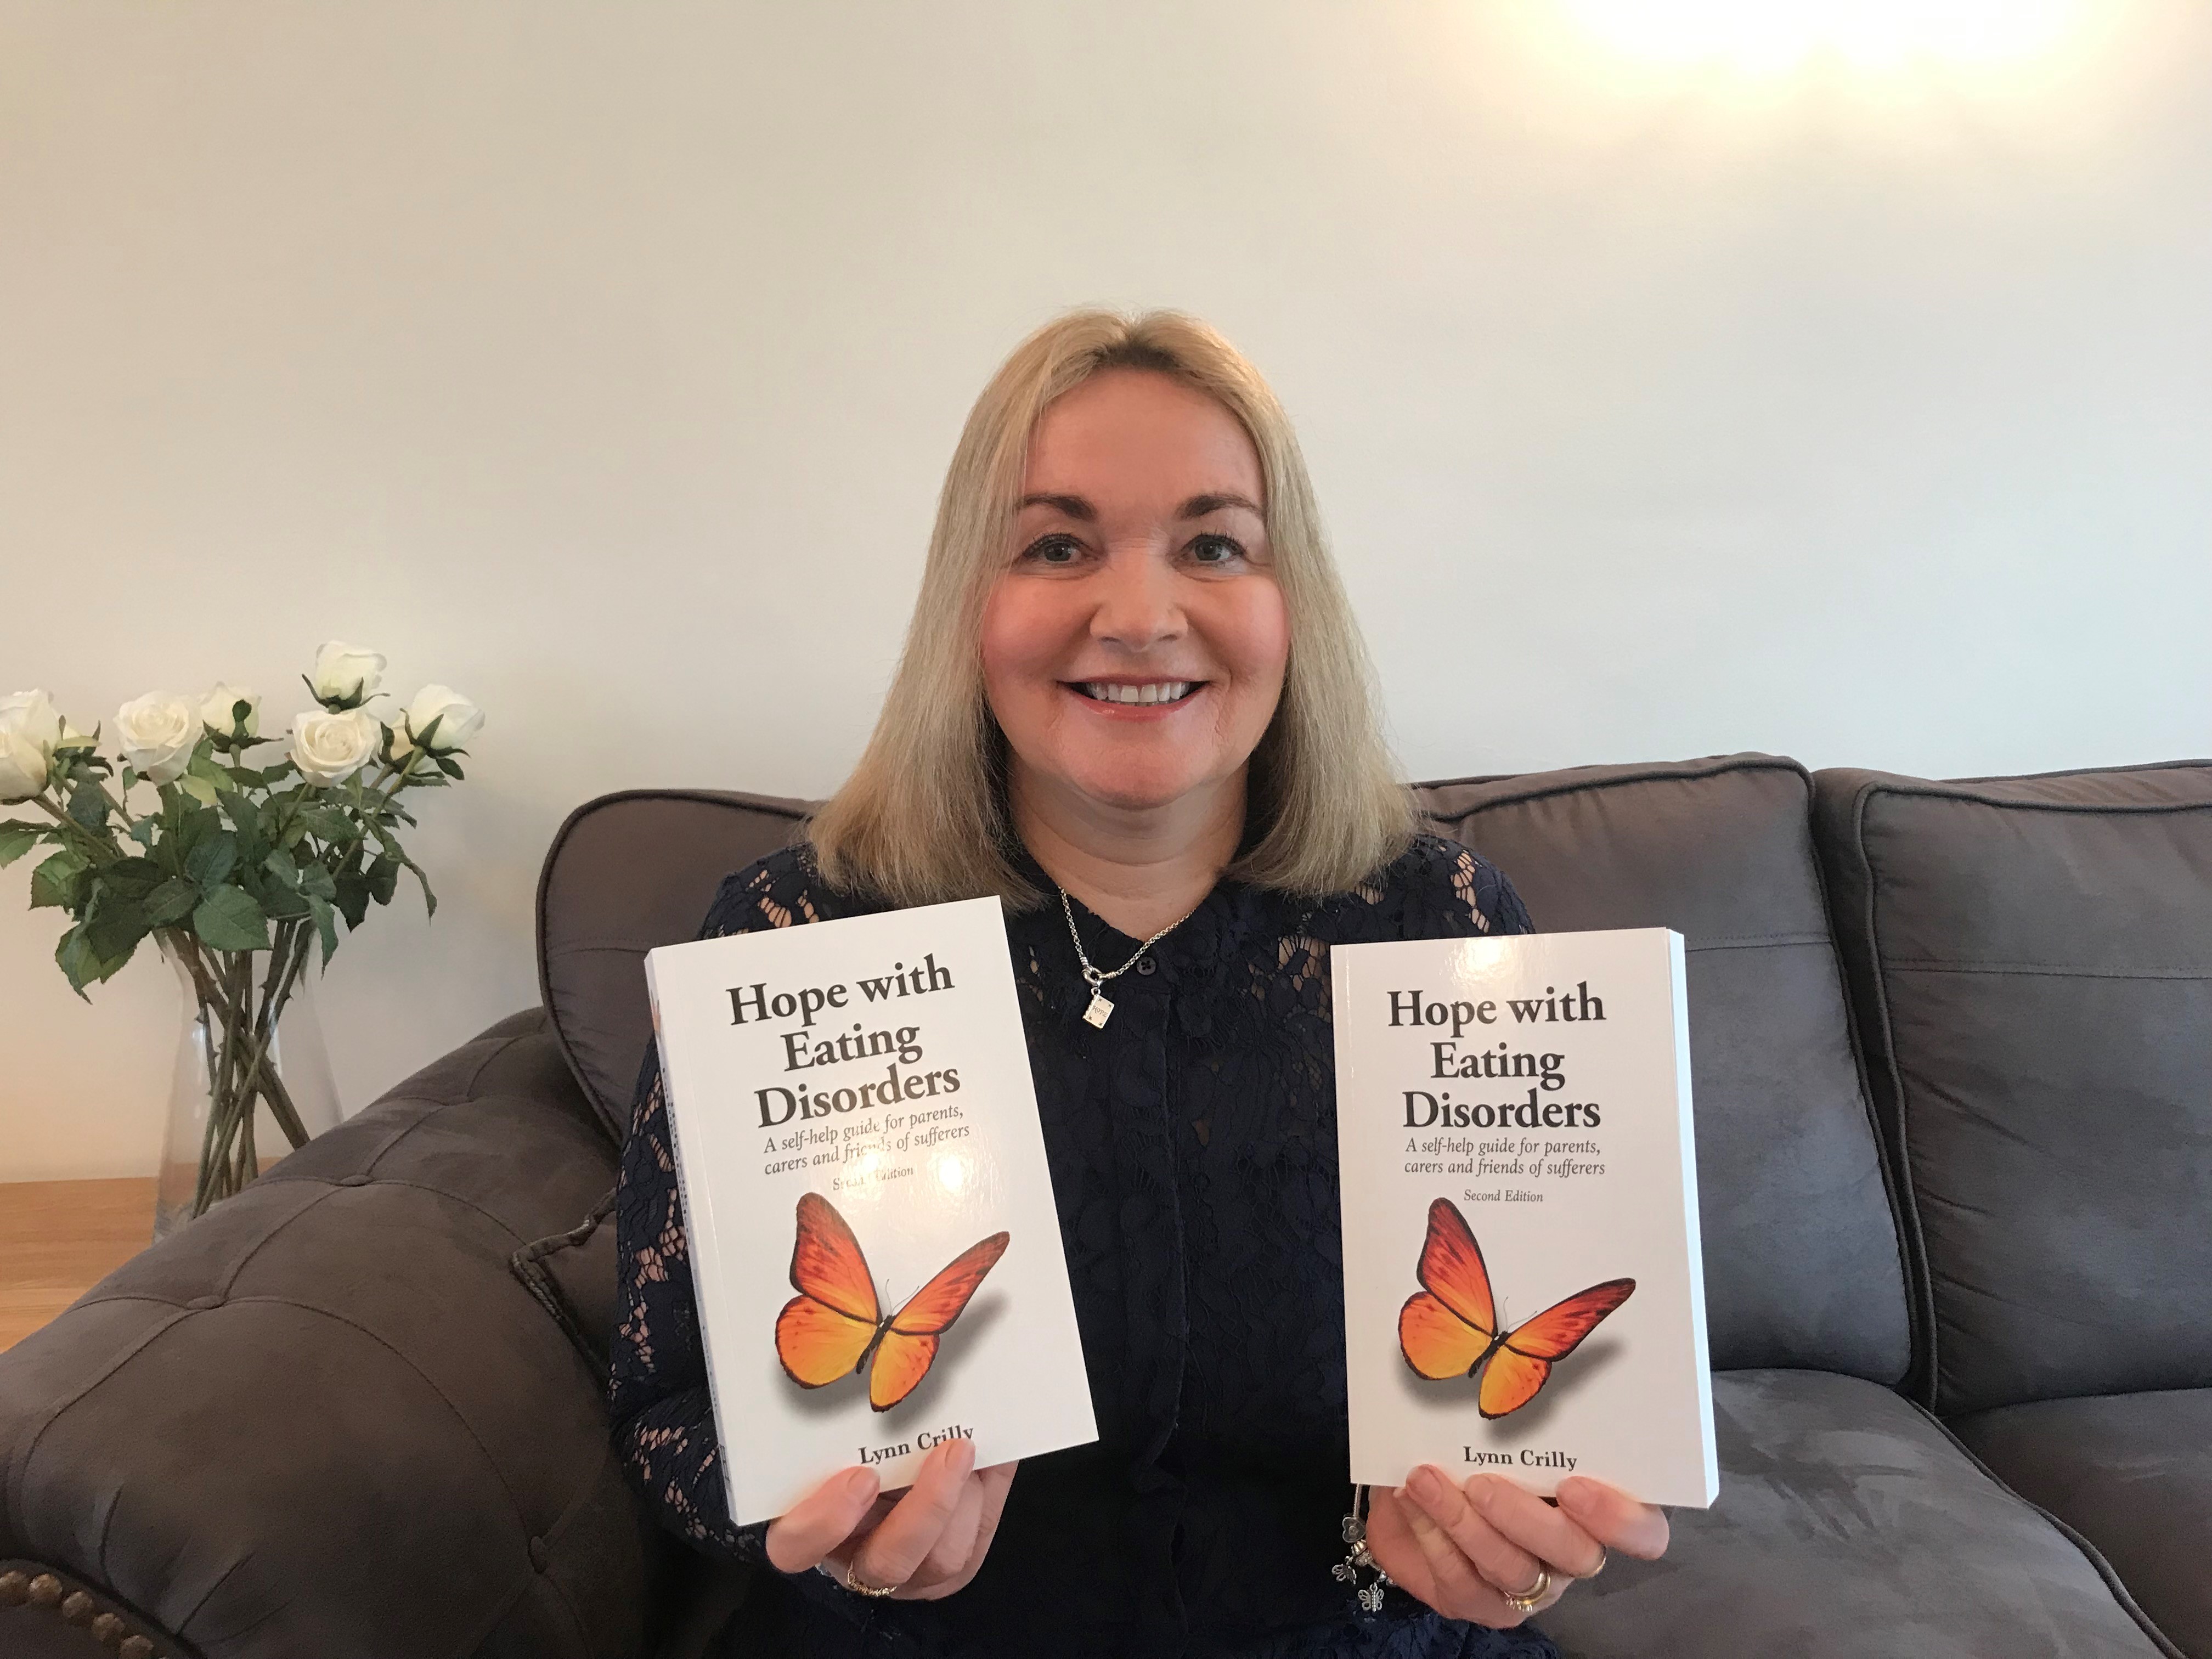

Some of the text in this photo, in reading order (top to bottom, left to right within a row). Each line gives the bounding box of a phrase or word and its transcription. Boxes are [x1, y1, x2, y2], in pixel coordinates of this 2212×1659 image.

[726, 953, 955, 1028] Hope with
[1386, 980, 1607, 1039] Hope with
[780, 1023, 923, 1072] Eating
[1430, 1042, 1565, 1091] Eating
[754, 1064, 961, 1128] Disorders
[1402, 1087, 1601, 1128] Disorders
[764, 1105, 963, 1153] A self-help guide for parents,
[765, 1157, 808, 1175] carers
[812, 1146, 839, 1166] and
[896, 1131, 911, 1152] of
[914, 1126, 969, 1147] sufferers
[1405, 1137, 1600, 1156] A self-help guide for parents,
[1404, 1158, 1605, 1178] carers and friends of sufferers
[1464, 1189, 1543, 1202] Second Edition
[858, 1443, 911, 1465] Lynn
[1464, 1446, 1577, 1471] Lynn Crilly
